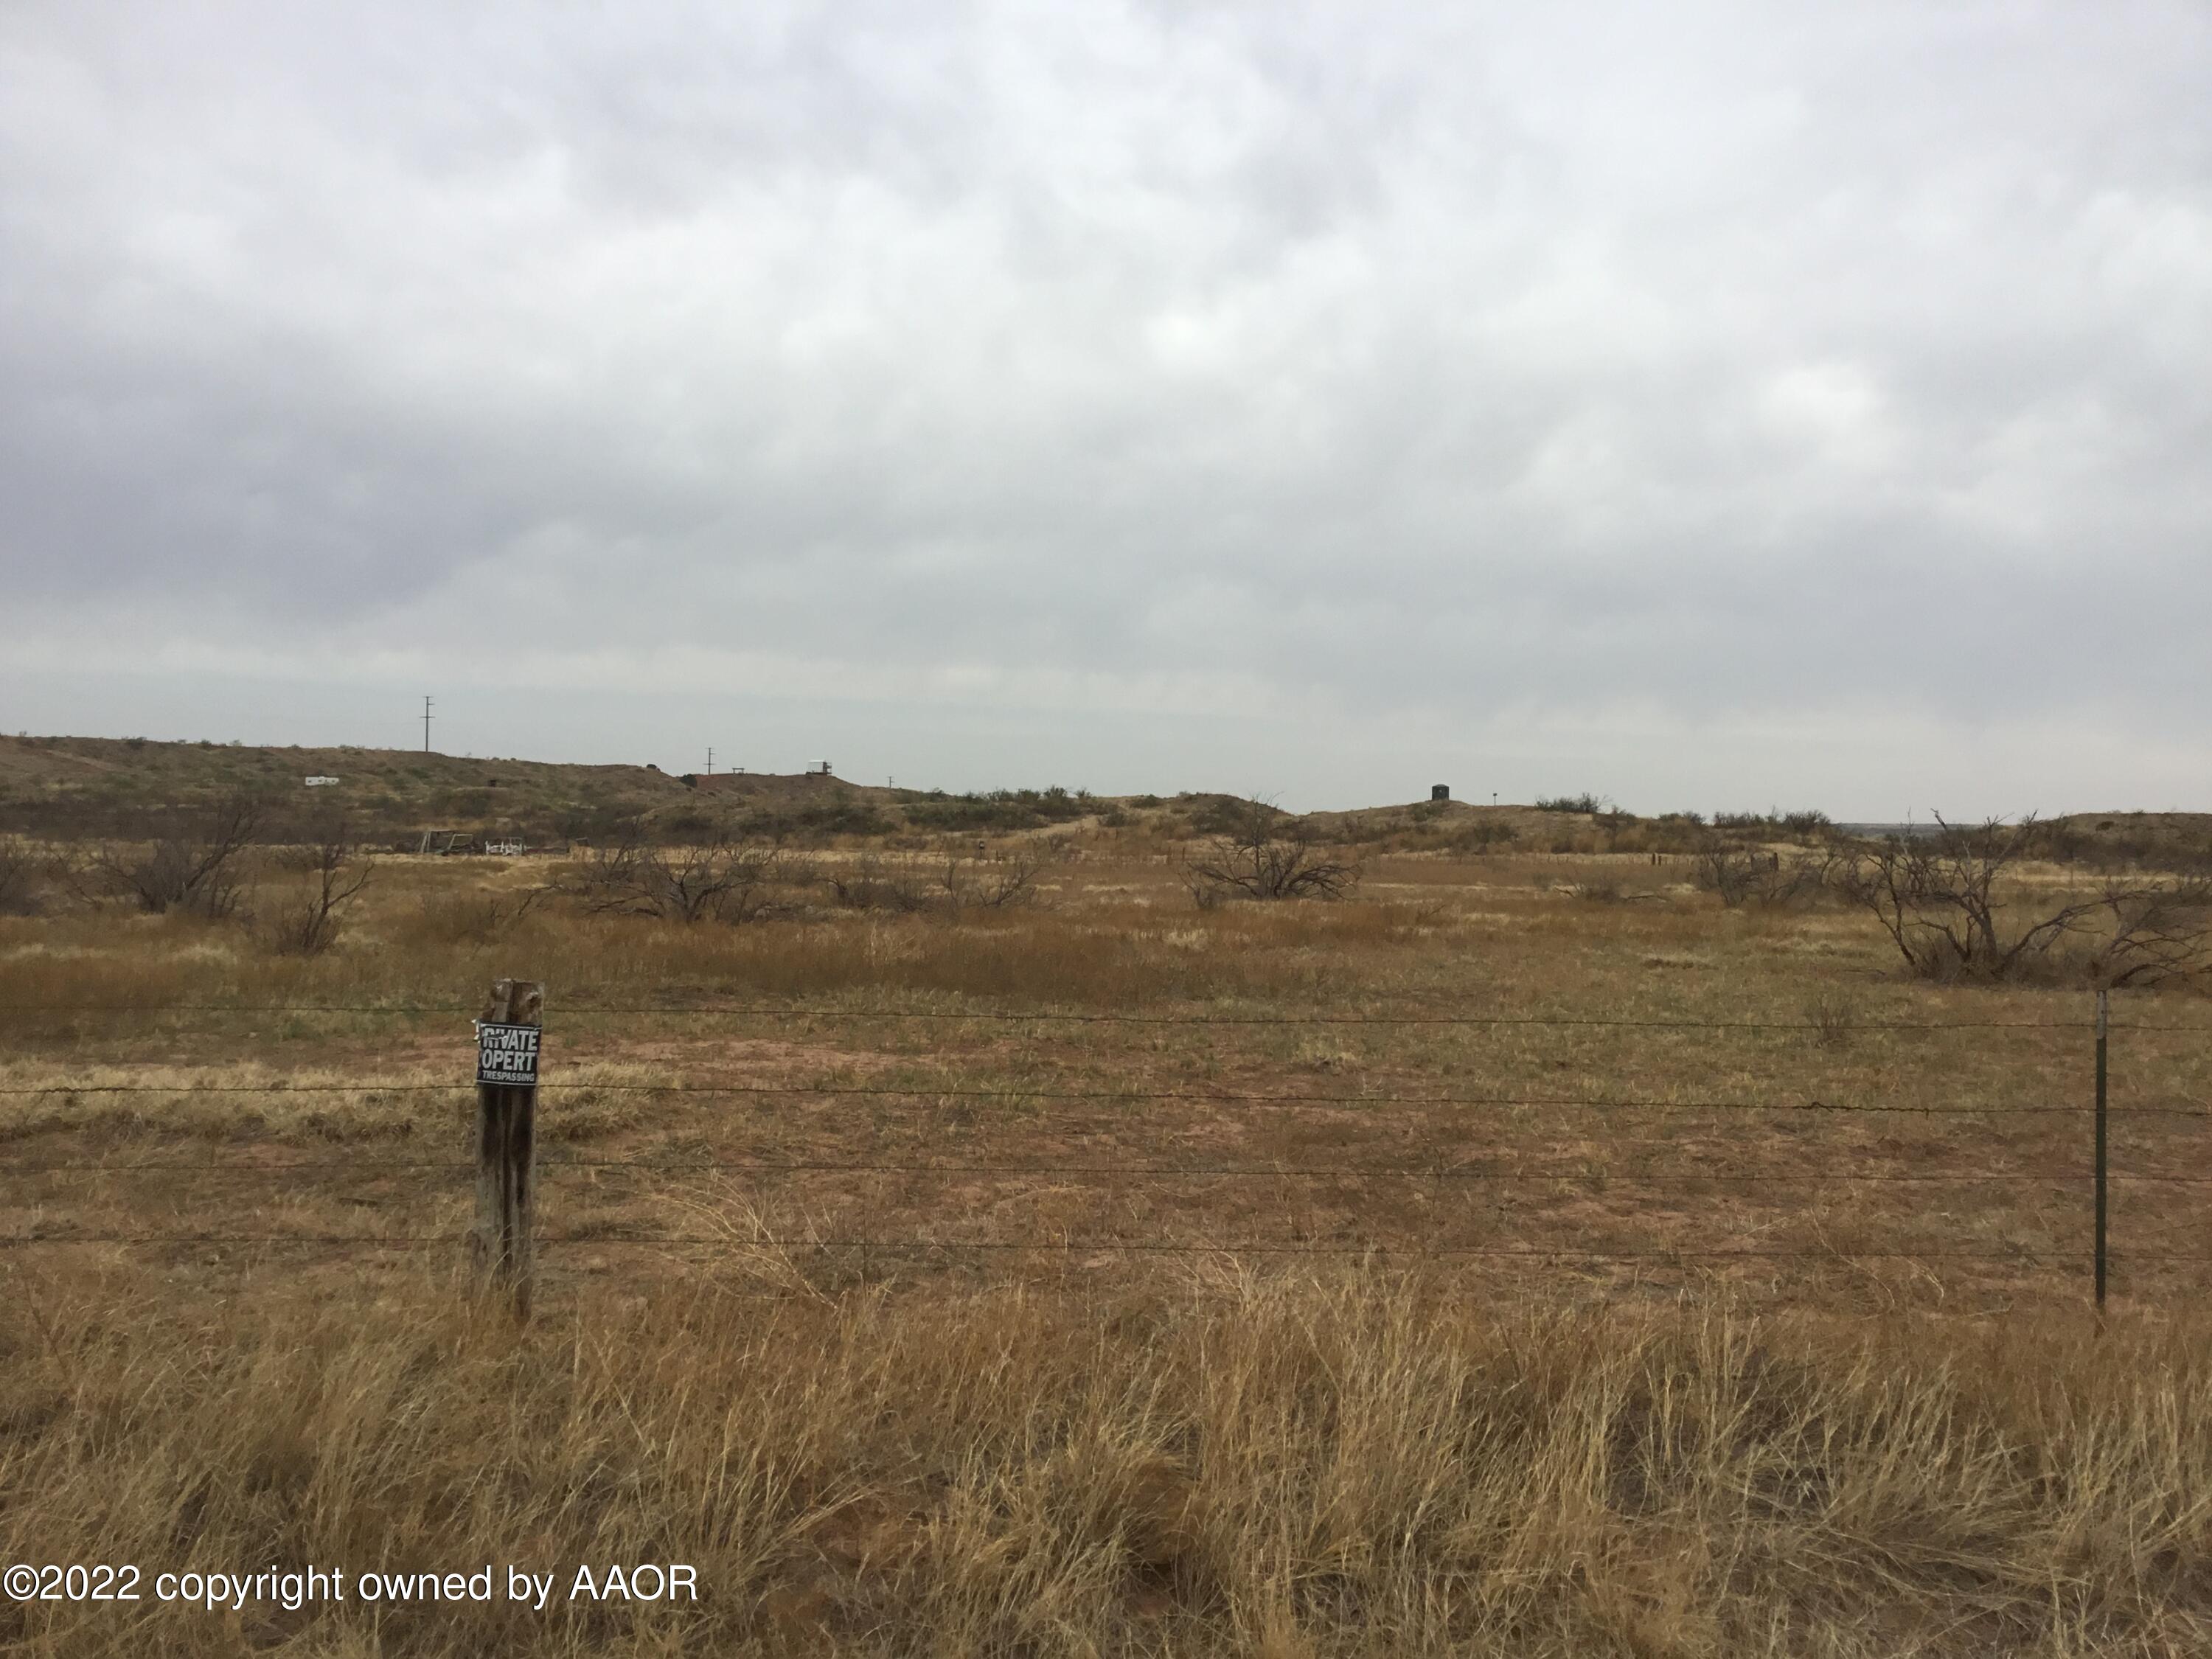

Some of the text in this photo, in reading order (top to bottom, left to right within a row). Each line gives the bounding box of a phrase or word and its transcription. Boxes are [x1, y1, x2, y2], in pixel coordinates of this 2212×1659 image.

[483, 1028, 539, 1051] RIVATE
[481, 1048, 536, 1071] OPERT
[482, 1070, 535, 1082] TRESPASSING
